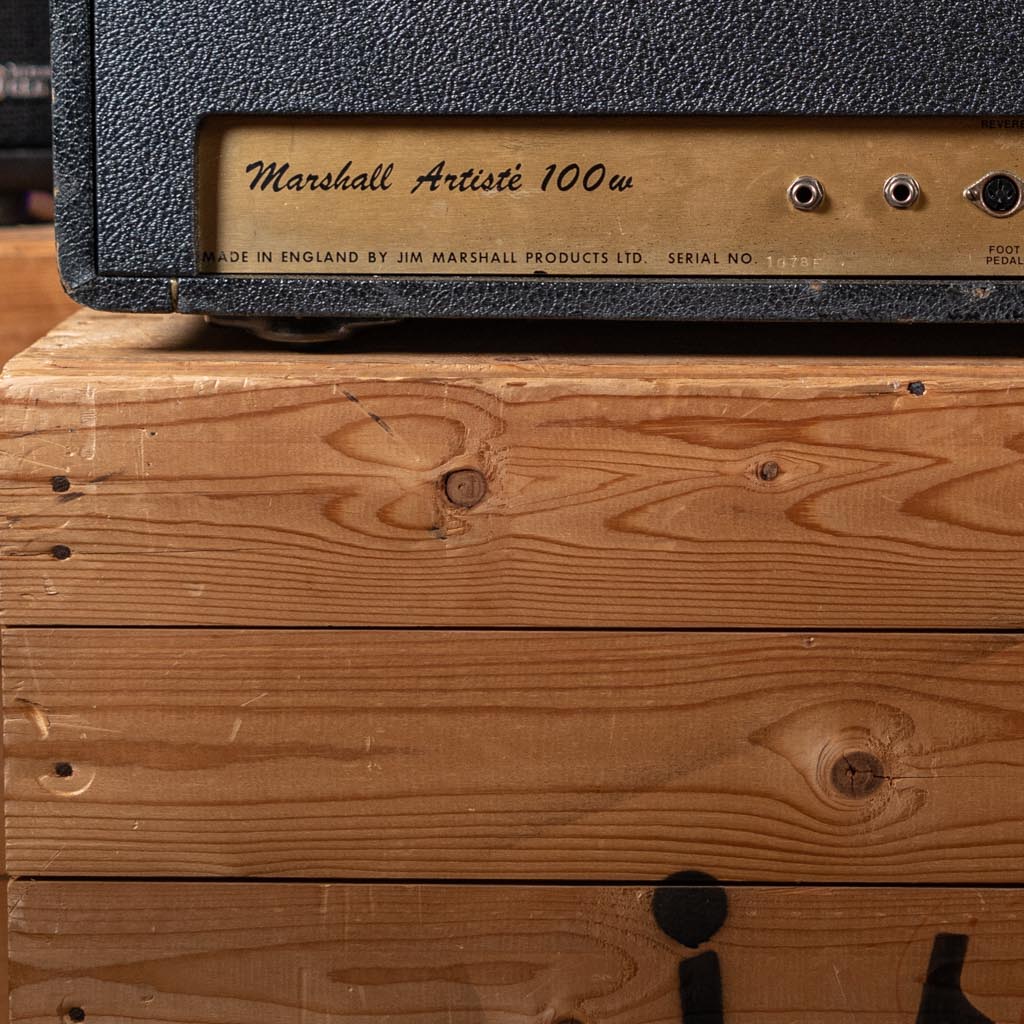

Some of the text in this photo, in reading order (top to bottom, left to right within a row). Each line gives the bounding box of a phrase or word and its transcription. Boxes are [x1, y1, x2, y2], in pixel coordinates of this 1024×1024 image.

[245, 160, 394, 192] Marshall
[540, 163, 634, 192] 100w
[989, 245, 1020, 254] FOOT
[202, 251, 249, 263] MADE
[257, 251, 273, 263] IN
[281, 251, 359, 263] ENGLAND
[368, 251, 388, 263] BY
[396, 251, 423, 264] JIM
[432, 252, 518, 264] MARSHALL
[525, 252, 609, 264] PRODUCTS
[617, 252, 648, 264] LTD.
[668, 252, 720, 264] SERIAL
[728, 252, 758, 264] NO.
[986, 256, 1024, 265] PEDAL
